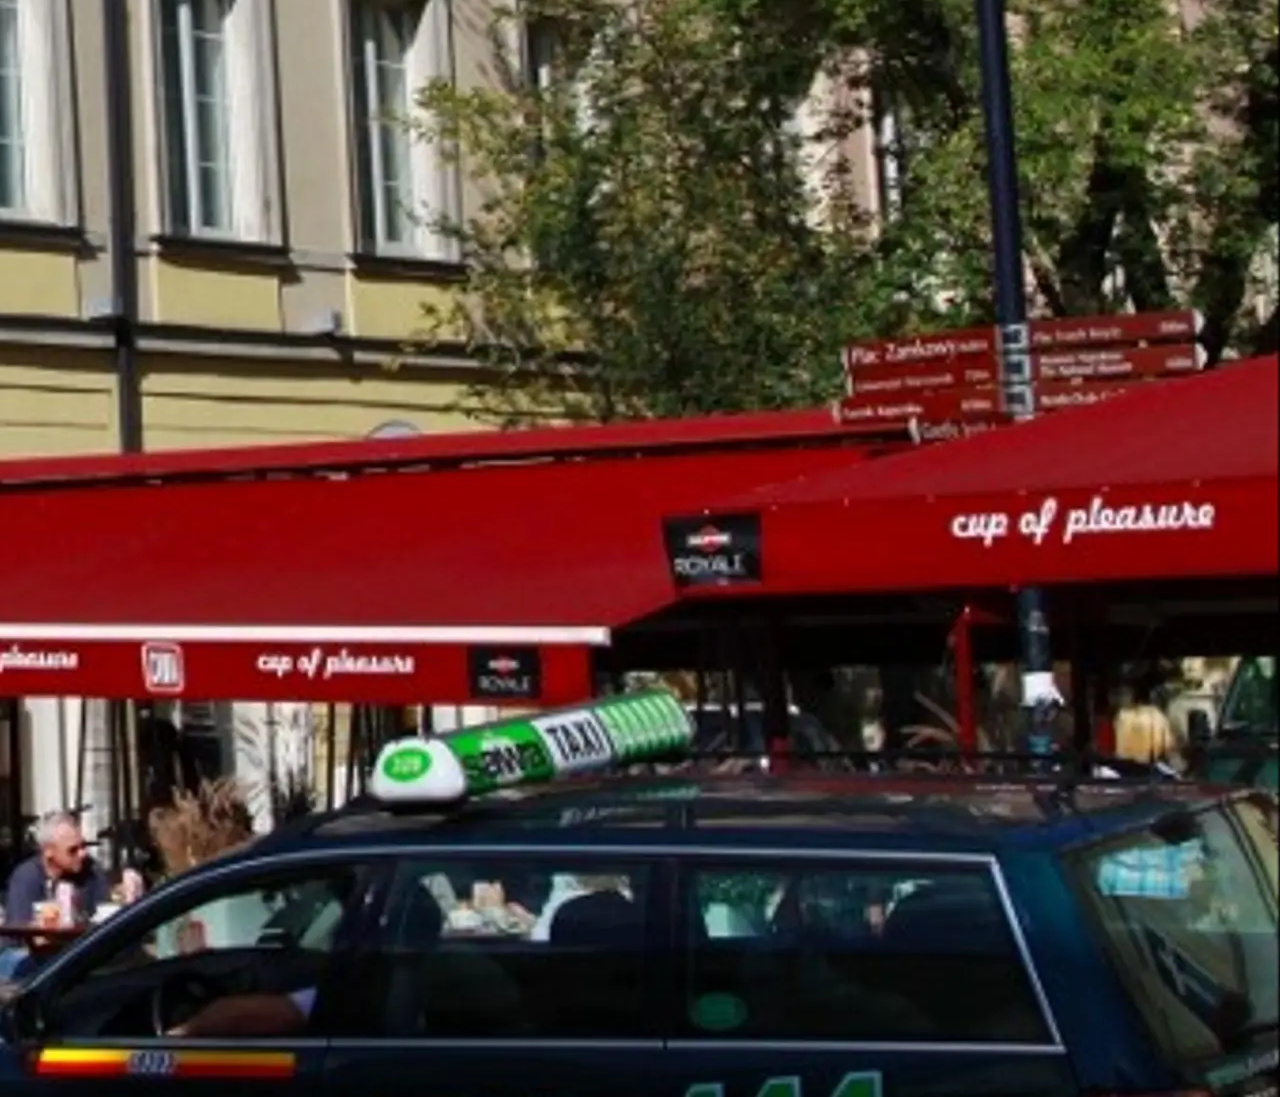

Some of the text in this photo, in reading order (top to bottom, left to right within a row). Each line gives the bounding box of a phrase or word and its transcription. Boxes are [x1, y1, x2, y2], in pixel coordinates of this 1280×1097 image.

[952, 495, 1215, 547] cup of pleasure
[256, 647, 415, 681] cup of pleasure
[546, 717, 605, 762] TAXI
